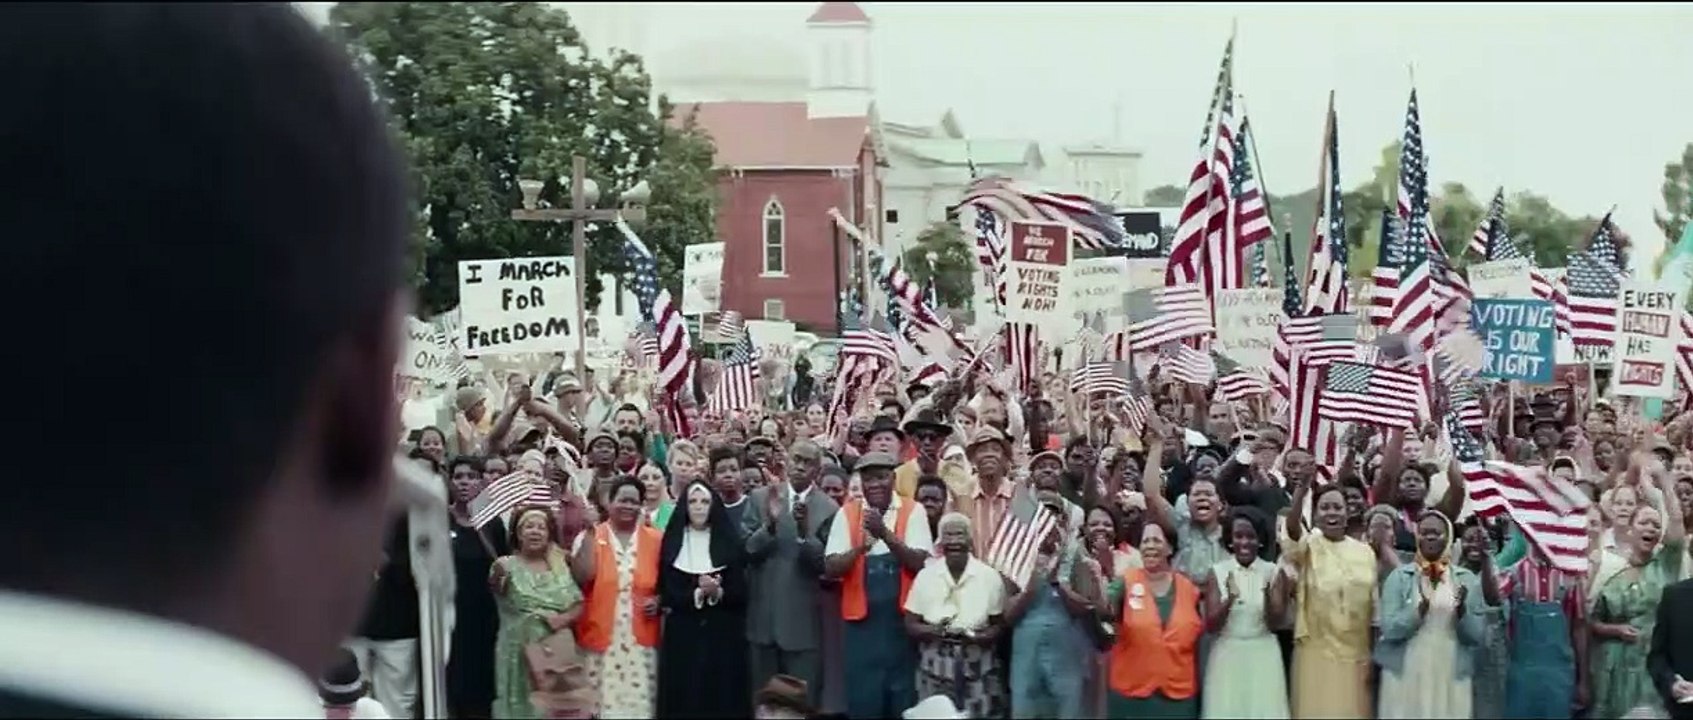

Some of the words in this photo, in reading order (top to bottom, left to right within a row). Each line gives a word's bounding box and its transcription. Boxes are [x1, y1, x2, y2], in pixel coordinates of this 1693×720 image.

[465, 264, 482, 284] I
[499, 260, 570, 281] MARCH
[1017, 267, 1060, 284] VOTING
[502, 285, 544, 311] FOR
[1017, 282, 1058, 297] RIGHTS
[1624, 290, 1676, 310] EVERY
[1474, 303, 1553, 328] VOTING
[467, 317, 570, 349] FREEDOM
[1510, 329, 1540, 353] OUR
[1482, 351, 1546, 377] RIGHT
